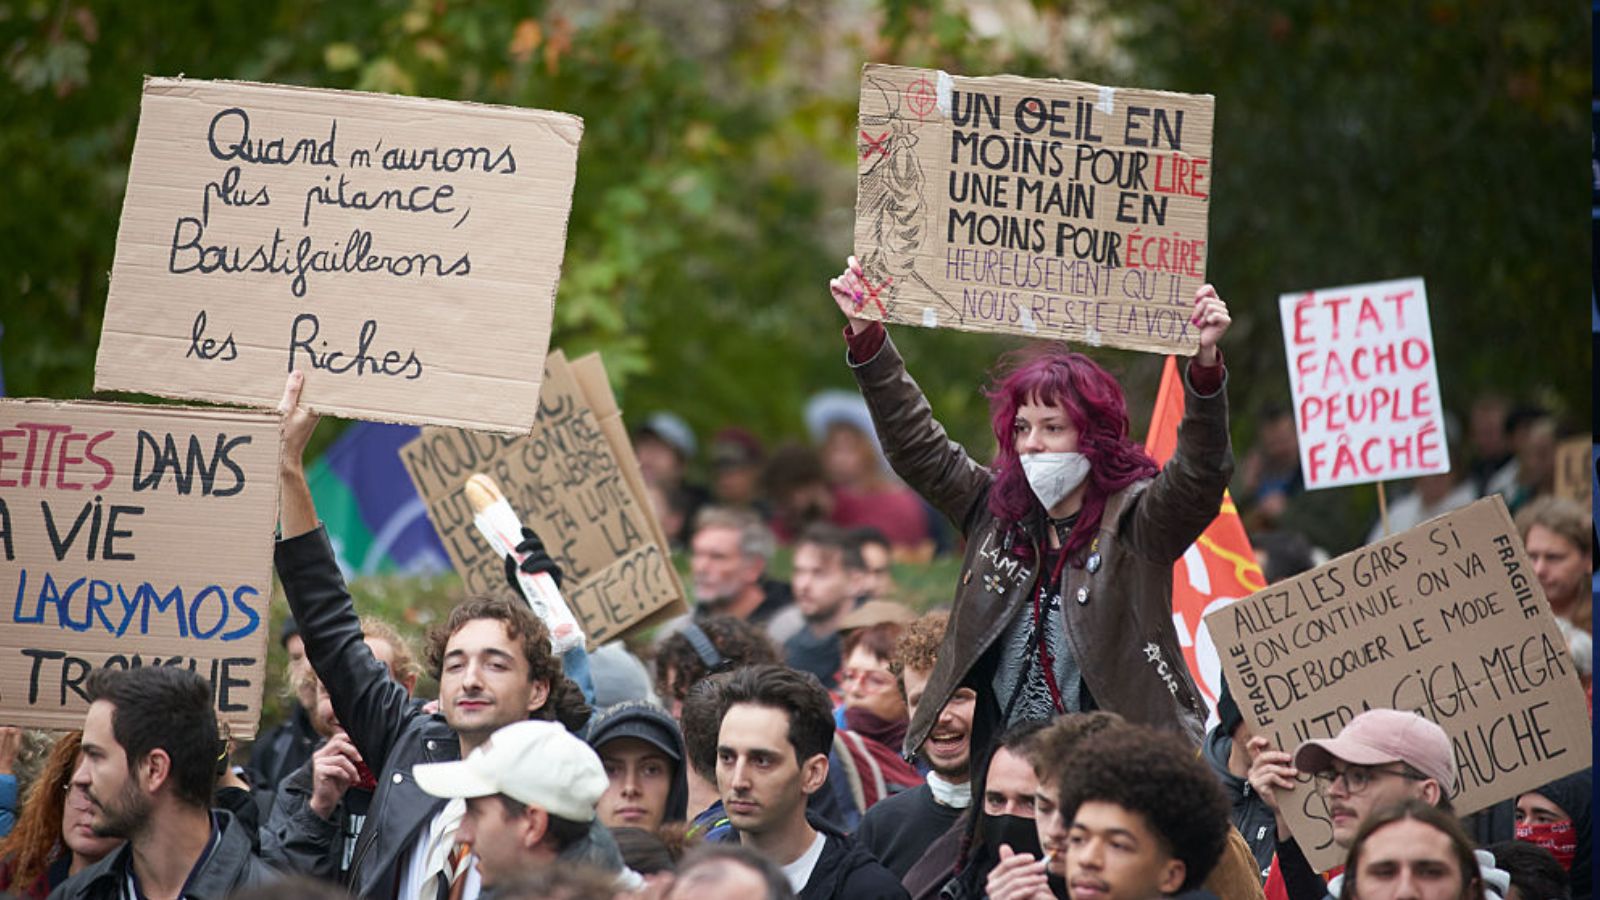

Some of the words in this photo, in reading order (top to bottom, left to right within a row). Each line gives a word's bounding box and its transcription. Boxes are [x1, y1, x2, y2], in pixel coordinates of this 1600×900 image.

[207, 107, 339, 168] Quand
[951, 91, 1001, 130] UN
[1124, 106, 1184, 150] EN
[950, 130, 1064, 178] MOINS
[1074, 143, 1149, 192] POUR
[202, 165, 271, 228] plus
[302, 174, 472, 229] pitance,
[949, 170, 1010, 208] UNE
[1015, 177, 1096, 220] MAIN
[1116, 191, 1169, 227] EN
[168, 217, 472, 298] Boustifaillerons
[947, 207, 1046, 254] MOINS
[1055, 221, 1122, 269] POUR
[945, 247, 1117, 297] HEUREUSEMENT
[962, 287, 1021, 323] NOUS
[1292, 290, 1414, 345] ÉTAT
[185, 309, 239, 361] les
[287, 312, 424, 379] Riches
[1296, 337, 1431, 394] FACHO
[1299, 381, 1433, 433] PEUPLE
[131, 429, 253, 497] DANS
[522, 407, 602, 474] CONTRE
[1307, 420, 1440, 483] FÂCHÉ
[600, 508, 643, 557] LA
[13, 568, 261, 642] LACRYMOS
[1234, 591, 1298, 639] ALLEZ
[1297, 566, 1346, 612] LES
[1492, 533, 1540, 620] FRAGILE
[1253, 632, 1291, 669] ON
[1416, 567, 1451, 597] ON
[1453, 551, 1487, 580] VA
[1263, 635, 1396, 712] DEBLOQUER
[1399, 617, 1433, 652] LE
[1439, 591, 1505, 633] MODE
[1228, 642, 1275, 728] FRAGILE
[1449, 700, 1568, 801] AUCHE
